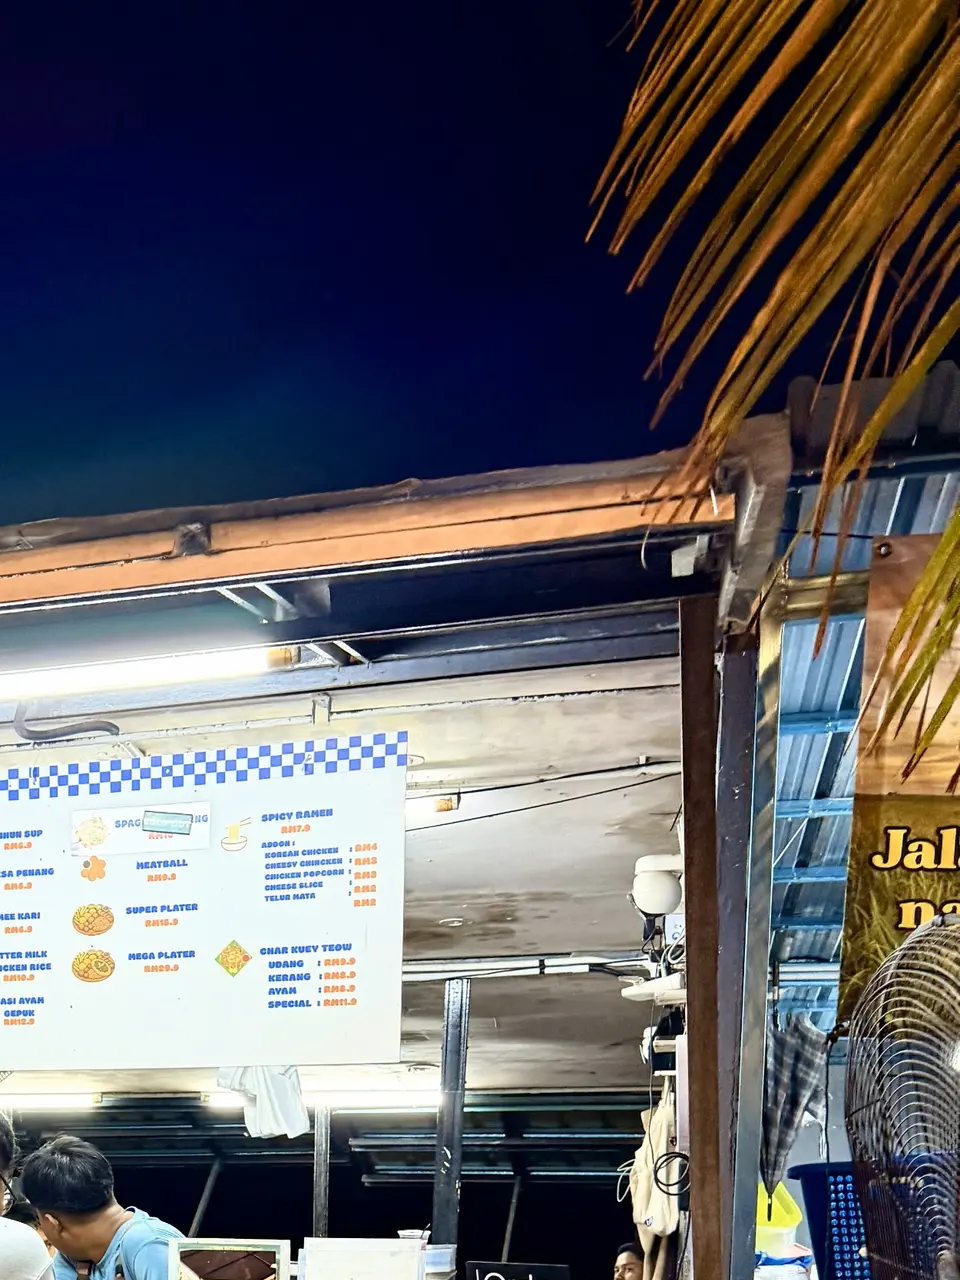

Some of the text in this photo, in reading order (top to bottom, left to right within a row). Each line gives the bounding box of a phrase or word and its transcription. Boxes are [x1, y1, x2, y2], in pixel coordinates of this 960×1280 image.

[261, 809, 333, 822] SPICY RAMEN
[24, 830, 43, 838] SUP
[265, 850, 299, 858] KOREAN
[301, 848, 339, 856] CHICKEN
[872, 828, 960, 869] Jal
[136, 860, 188, 869] MEATBALL
[16, 868, 54, 876] PENANG
[264, 872, 301, 880] CHICKEN
[303, 869, 344, 877] POPCORN
[264, 883, 297, 891] CHEESE
[298, 881, 323, 889] SLICE
[126, 904, 199, 914] SUPER PLATER
[18, 912, 41, 920] KARI
[260, 944, 352, 955] CHAR KUEY TEOW
[128, 951, 196, 960] MEGA PLATER
[29, 963, 52, 971] RICE
[268, 973, 311, 982] KERANG
[268, 987, 297, 995] AYAM
[268, 1000, 311, 1008] SPECIAL
